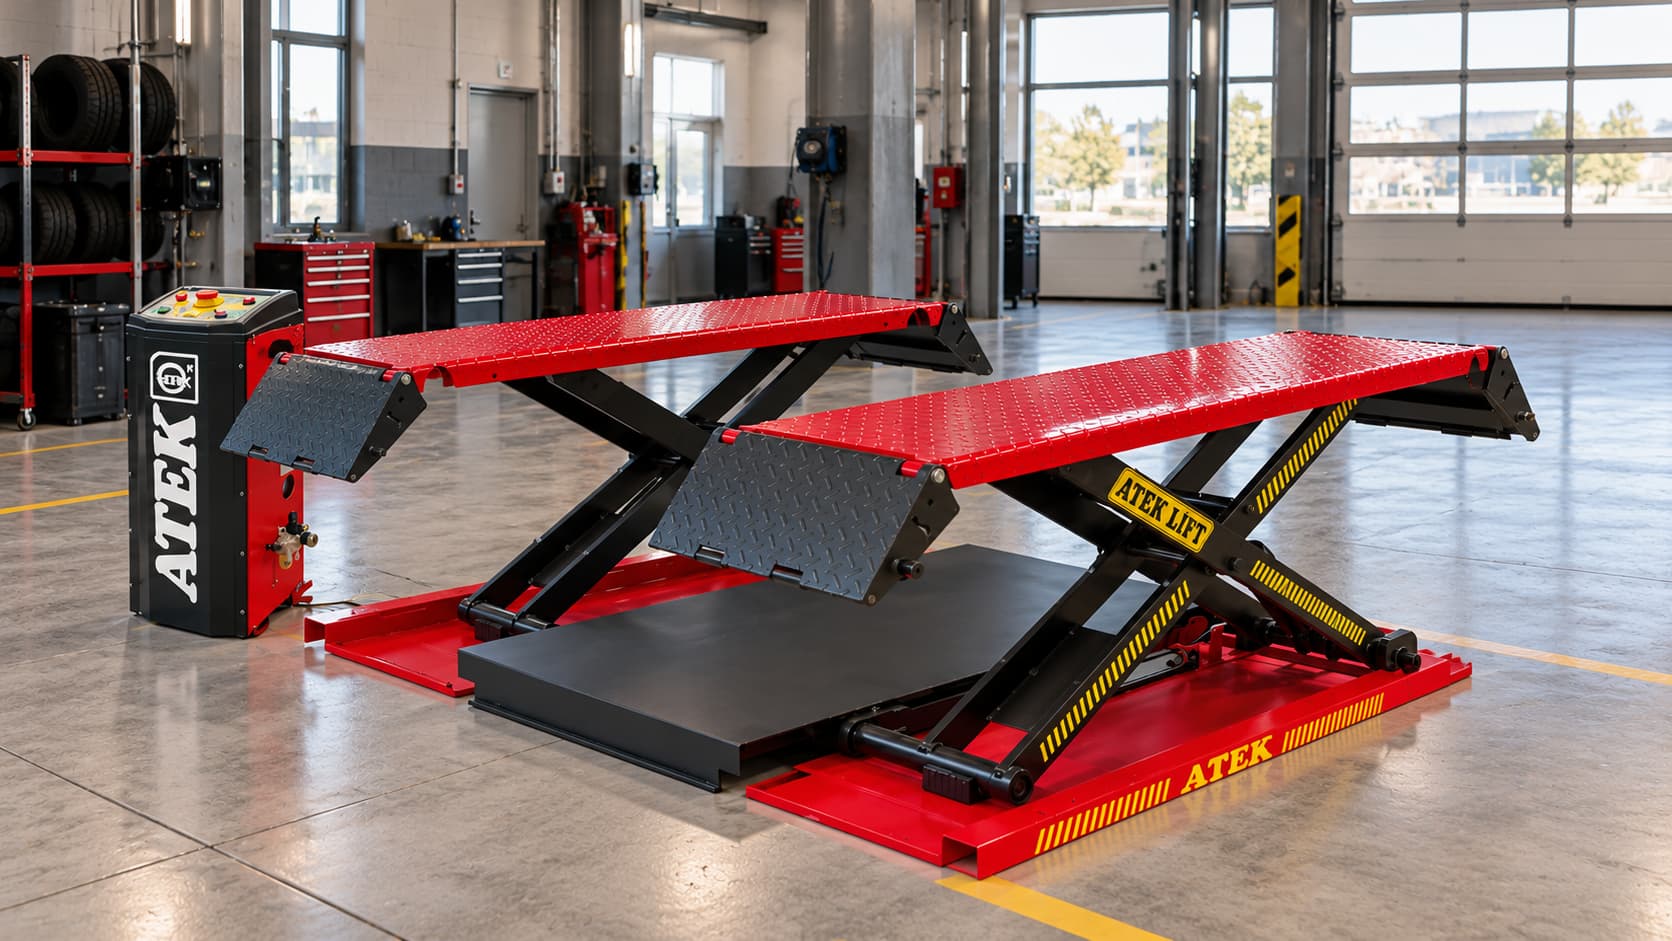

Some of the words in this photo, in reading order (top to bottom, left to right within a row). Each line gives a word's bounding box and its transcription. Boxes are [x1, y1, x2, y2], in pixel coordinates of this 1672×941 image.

[152, 402, 198, 604] ATEK
[1115, 477, 1168, 522] ATEK
[1180, 735, 1272, 795] ATEK
